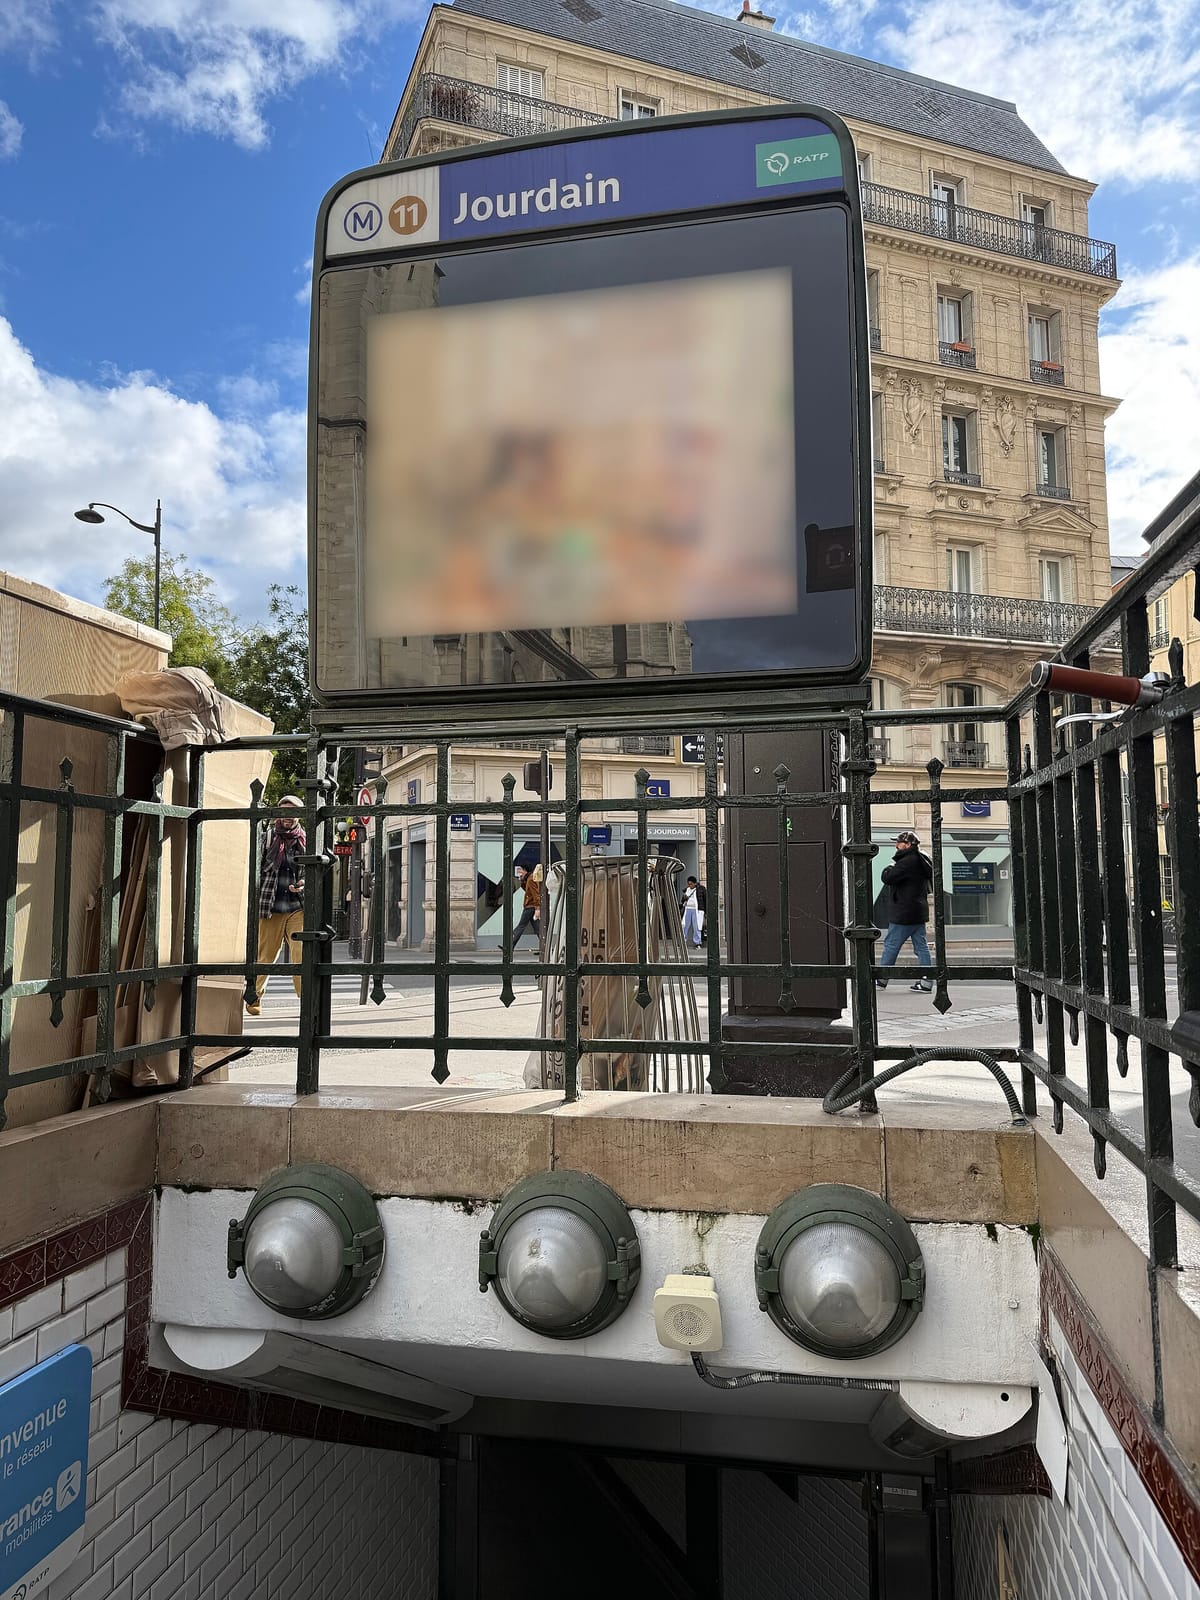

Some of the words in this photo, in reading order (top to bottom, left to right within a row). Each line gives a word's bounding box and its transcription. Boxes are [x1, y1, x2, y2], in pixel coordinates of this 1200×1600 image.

[793, 152, 829, 164] RATP
[393, 202, 419, 228] 11
[453, 173, 620, 225] Jourdain
[645, 785, 668, 796] CL
[653, 828, 690, 836] JOURDAIN
[3, 1463, 14, 1480] le
[16, 1434, 53, 1470] réseau
[5, 1509, 53, 1557] mobilités
[28, 1567, 50, 1590] RATP
